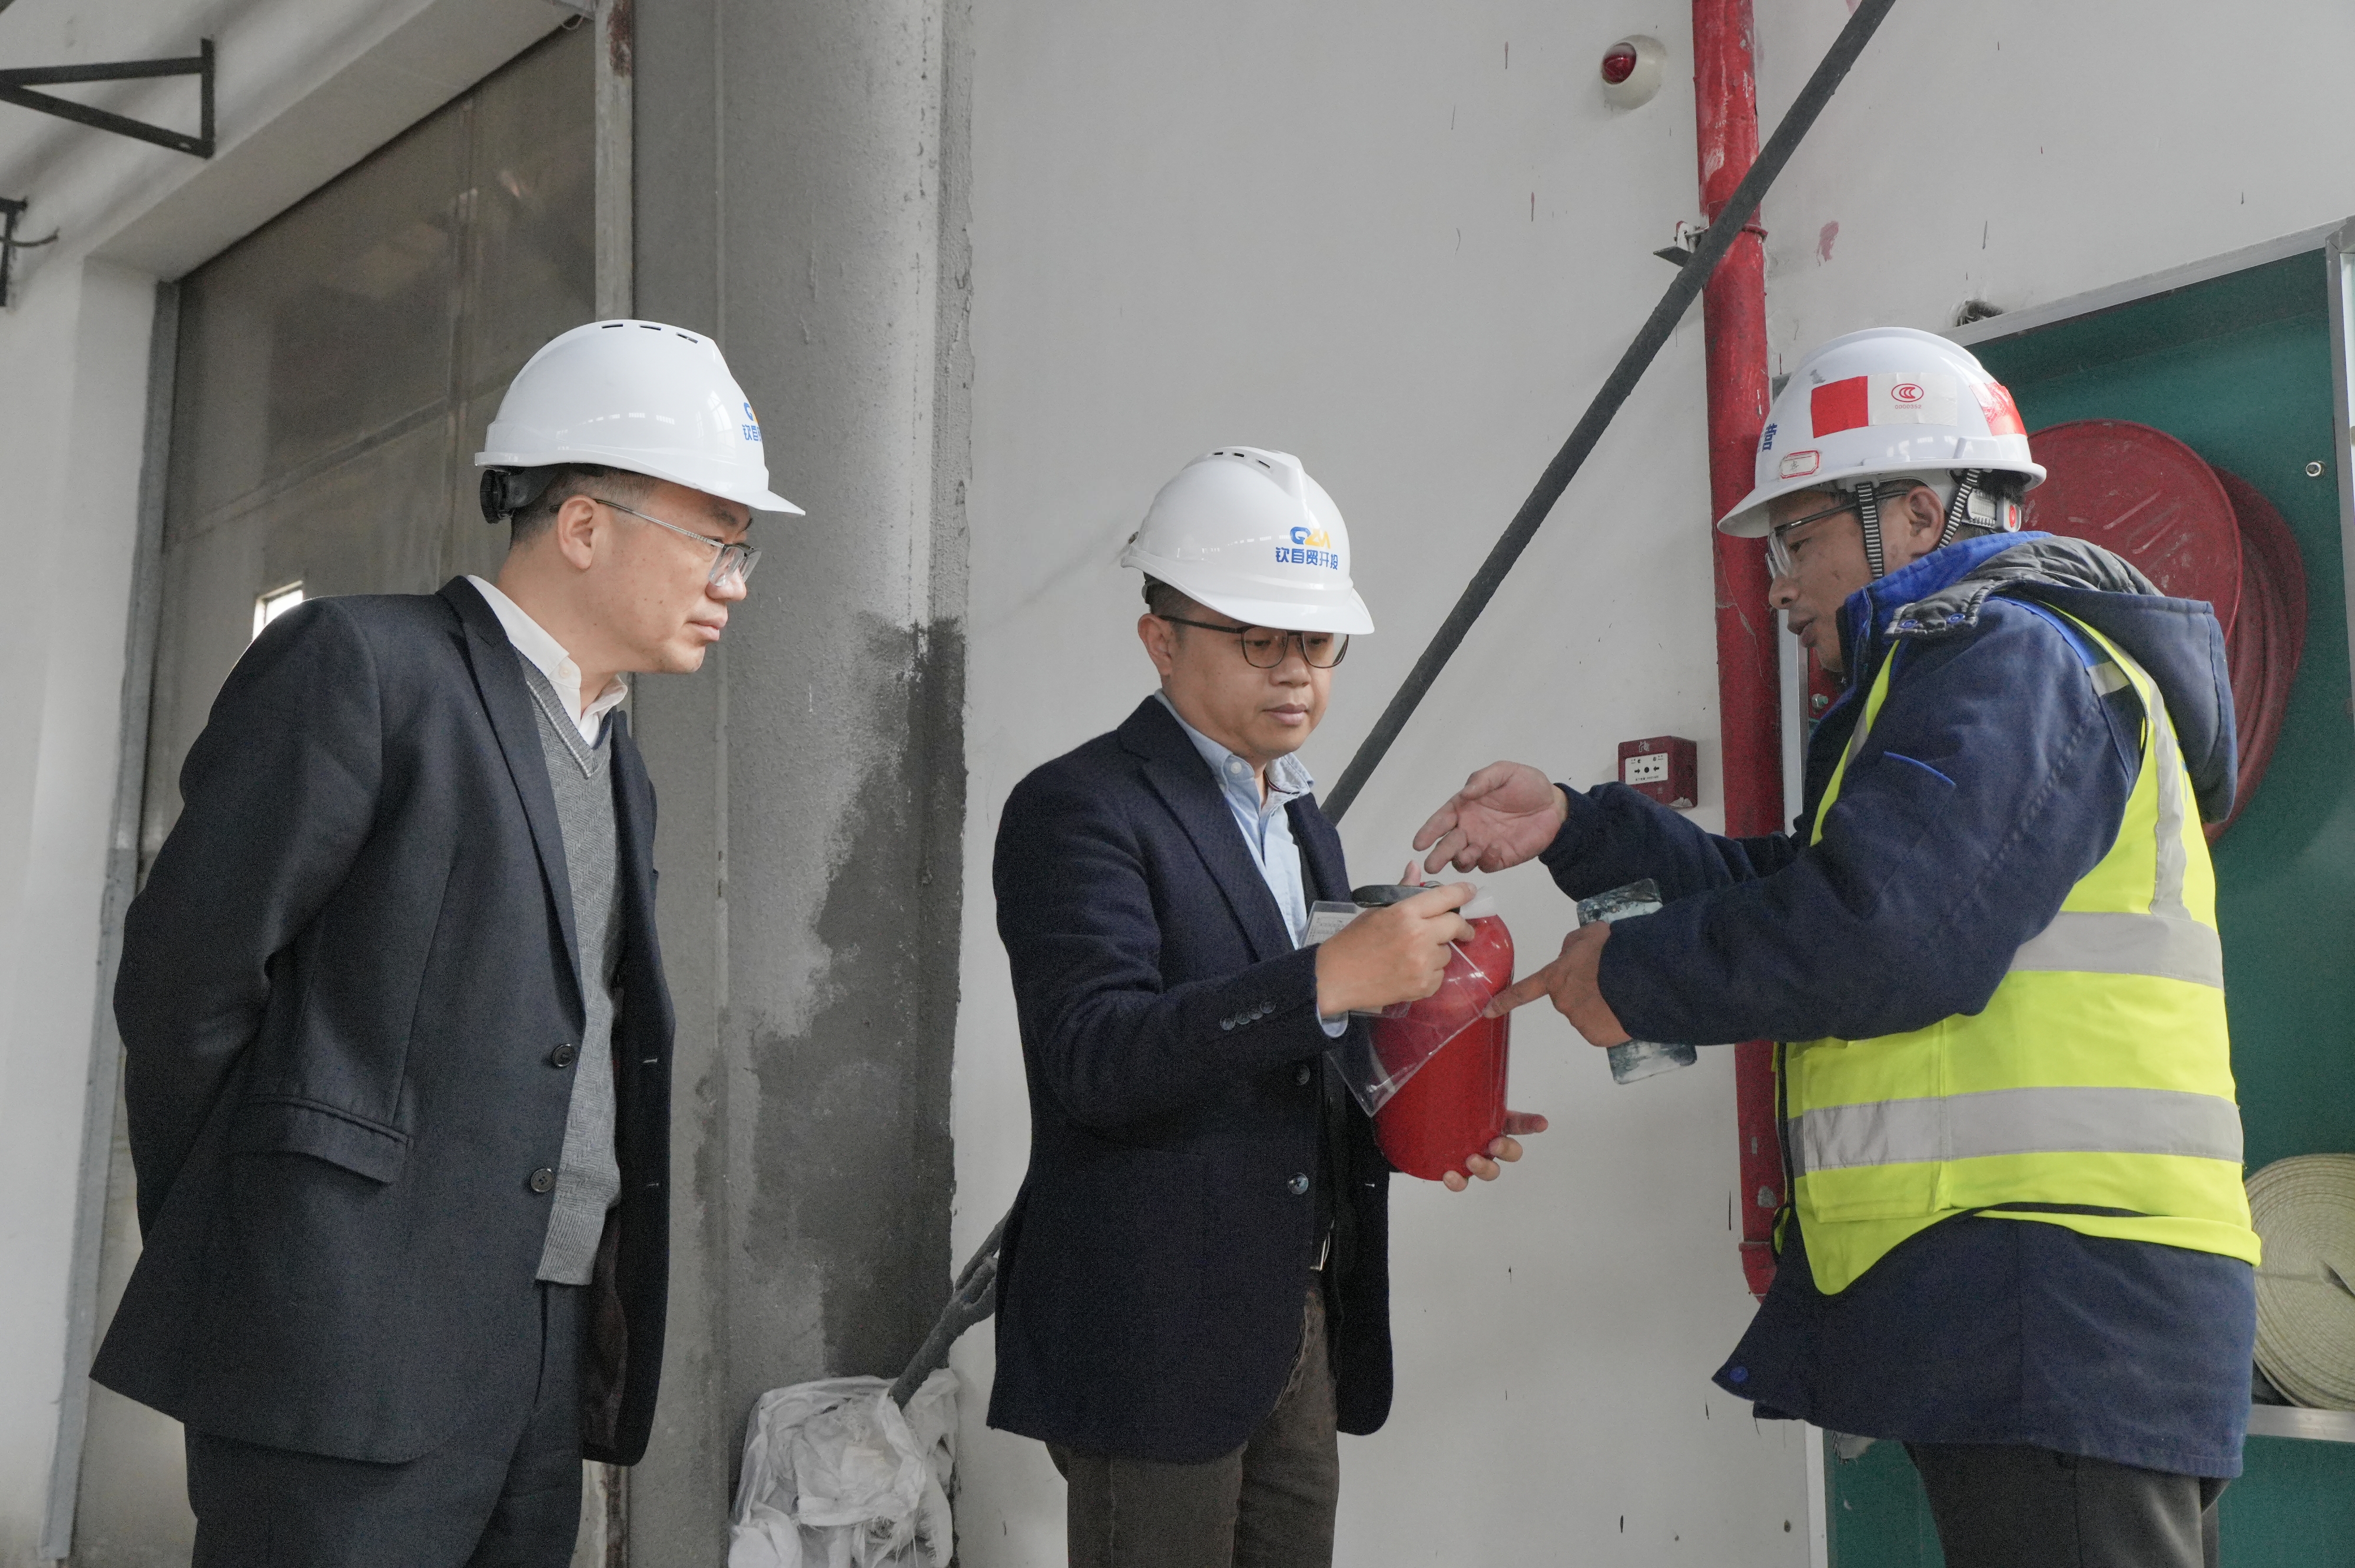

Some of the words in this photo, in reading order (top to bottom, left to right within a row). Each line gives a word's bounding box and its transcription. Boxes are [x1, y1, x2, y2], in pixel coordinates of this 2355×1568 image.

[1275, 546, 1338, 570] 钦自贸开投
